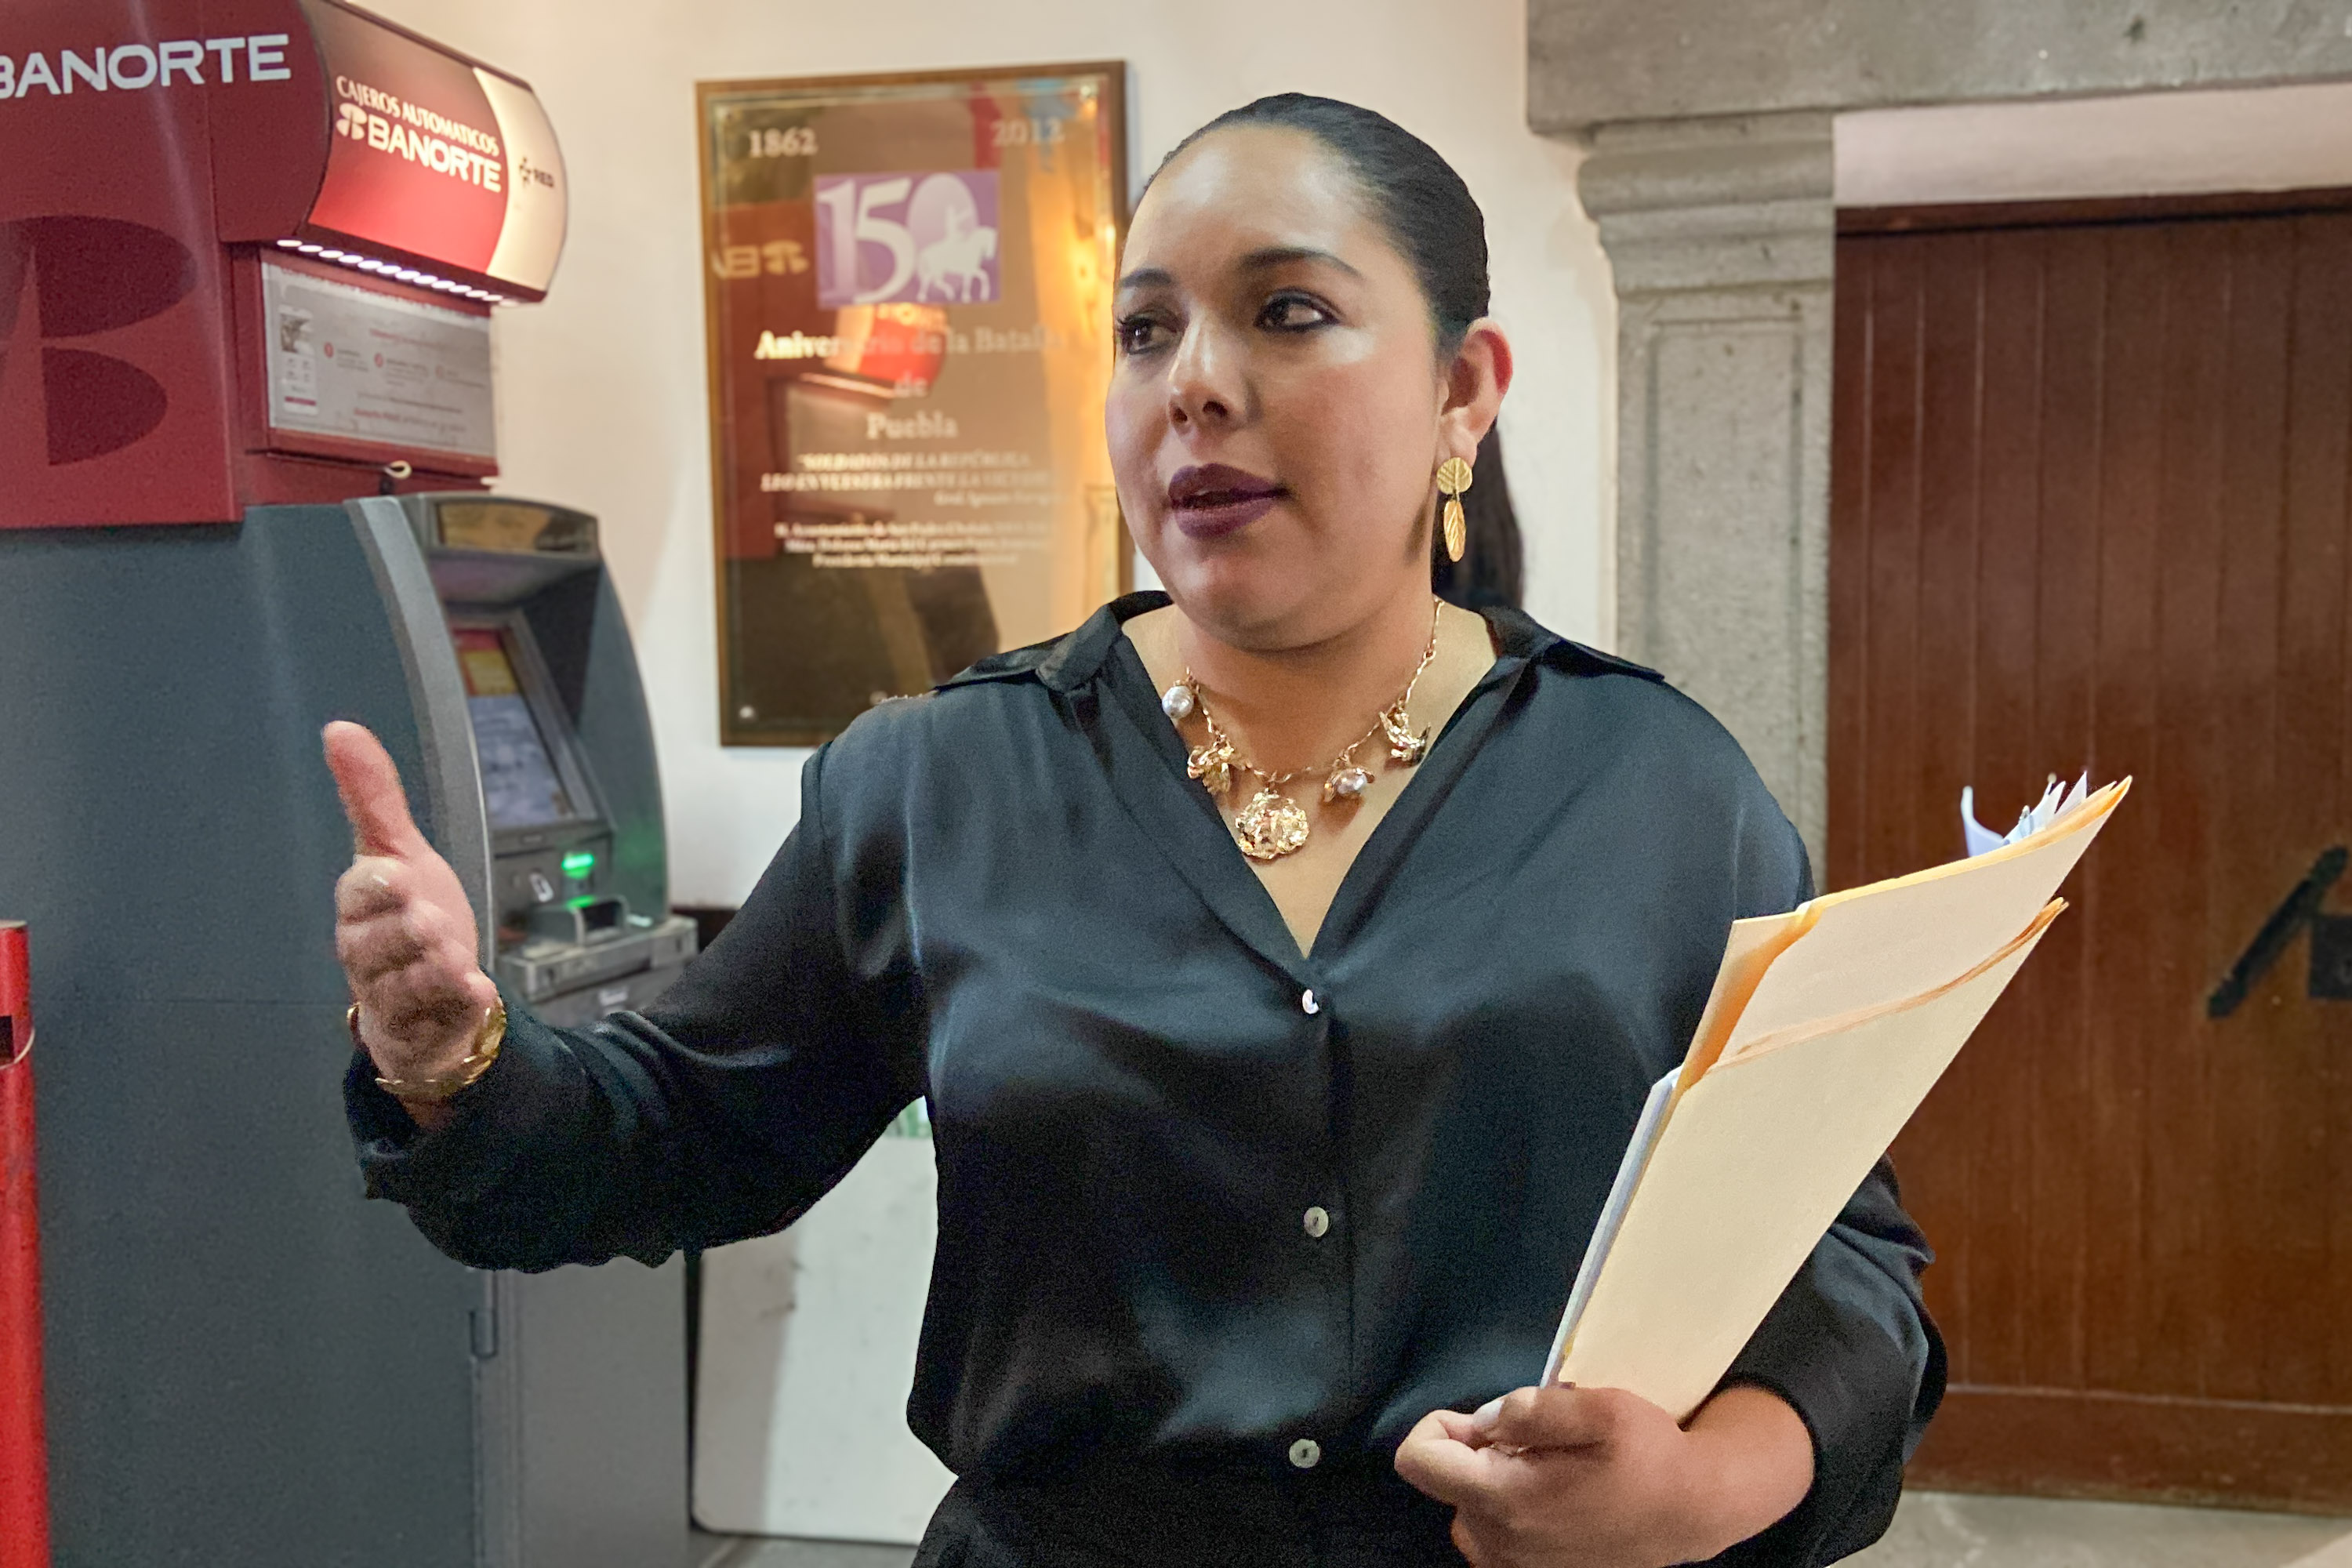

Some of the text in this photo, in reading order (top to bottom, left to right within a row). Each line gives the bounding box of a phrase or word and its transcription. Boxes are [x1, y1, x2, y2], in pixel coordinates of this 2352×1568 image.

[336, 75, 499, 157] CAJEROS AUTOMATICOS
[750, 126, 818, 158] 1862
[990, 118, 1065, 146] 2012
[368, 114, 501, 193] BANORTE
[910, 330, 940, 354] de
[945, 325, 971, 354] la
[894, 370, 928, 397] de
[866, 409, 958, 439] Puebla
